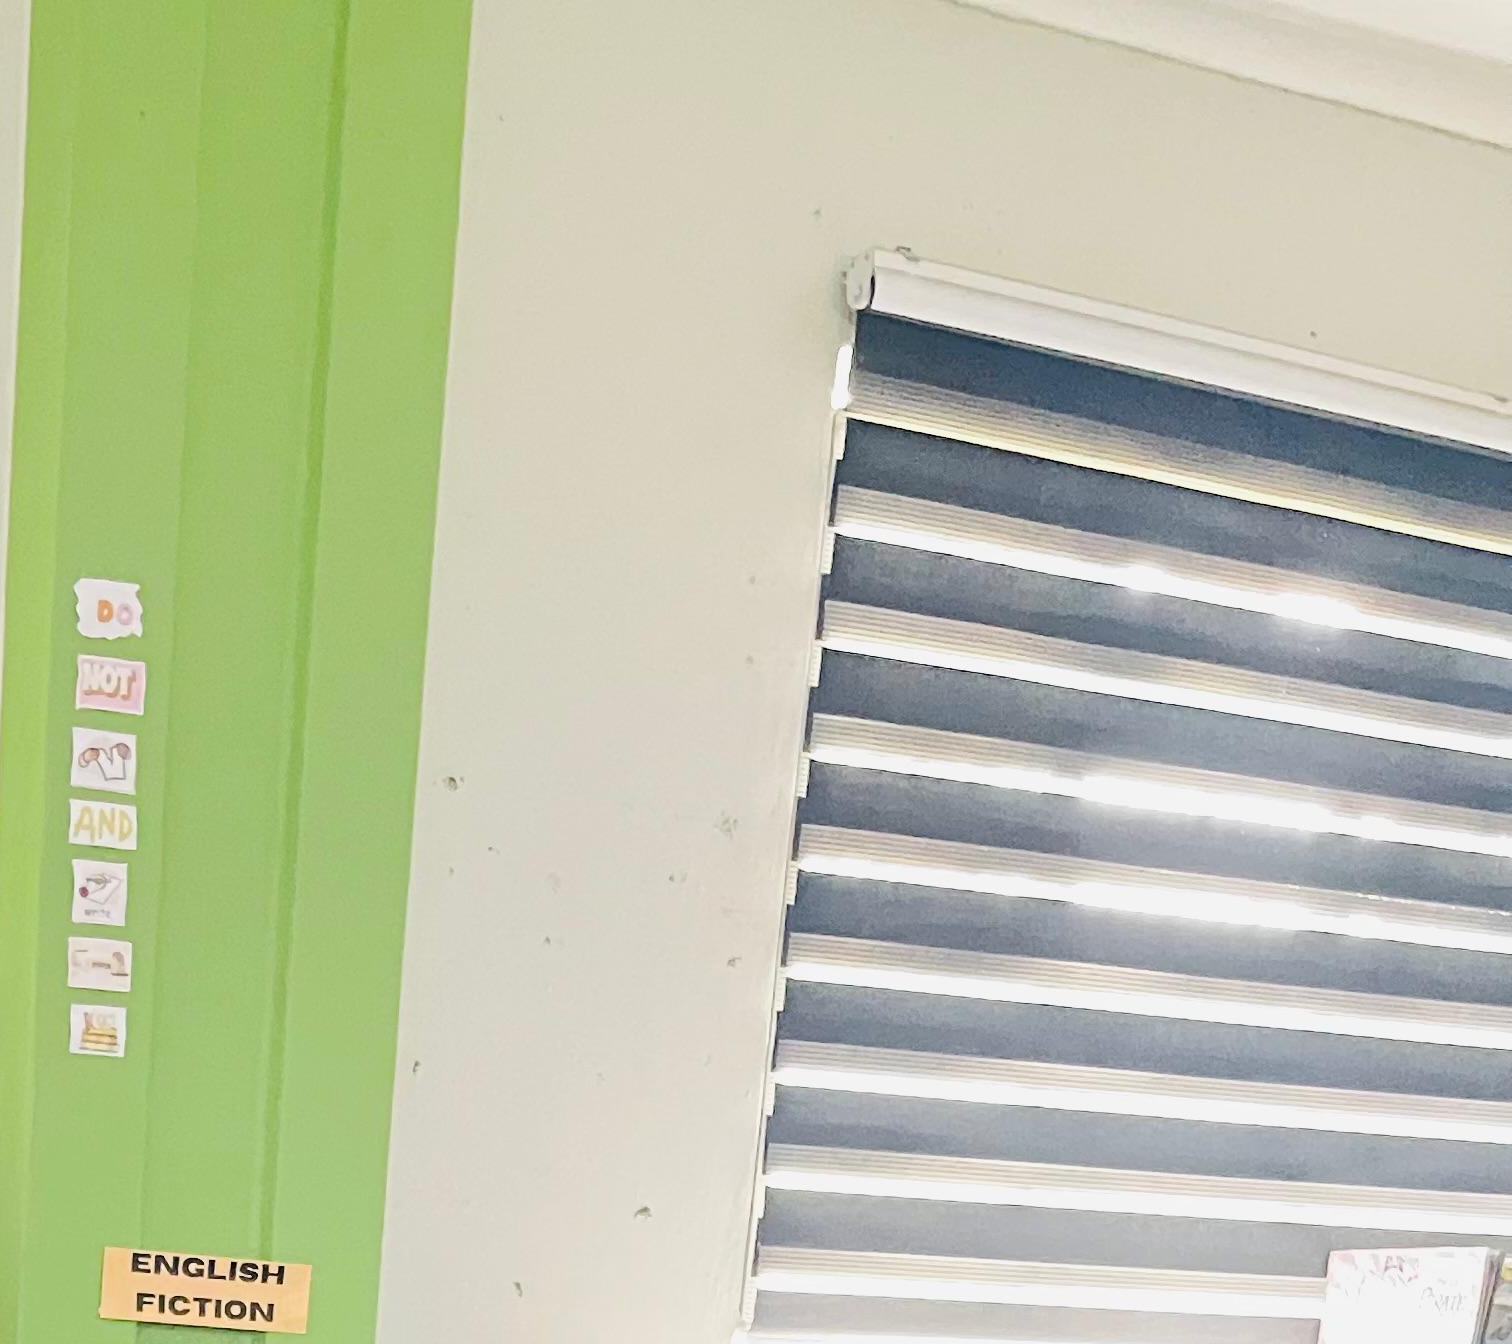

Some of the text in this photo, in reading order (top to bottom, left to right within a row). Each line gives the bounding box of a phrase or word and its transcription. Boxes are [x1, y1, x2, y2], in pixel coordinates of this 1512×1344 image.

[97, 599, 133, 626] DO
[82, 662, 136, 700] NOT
[73, 805, 133, 843] AND
[131, 1252, 285, 1285] ENGLISH
[136, 1293, 275, 1323] FICTION
